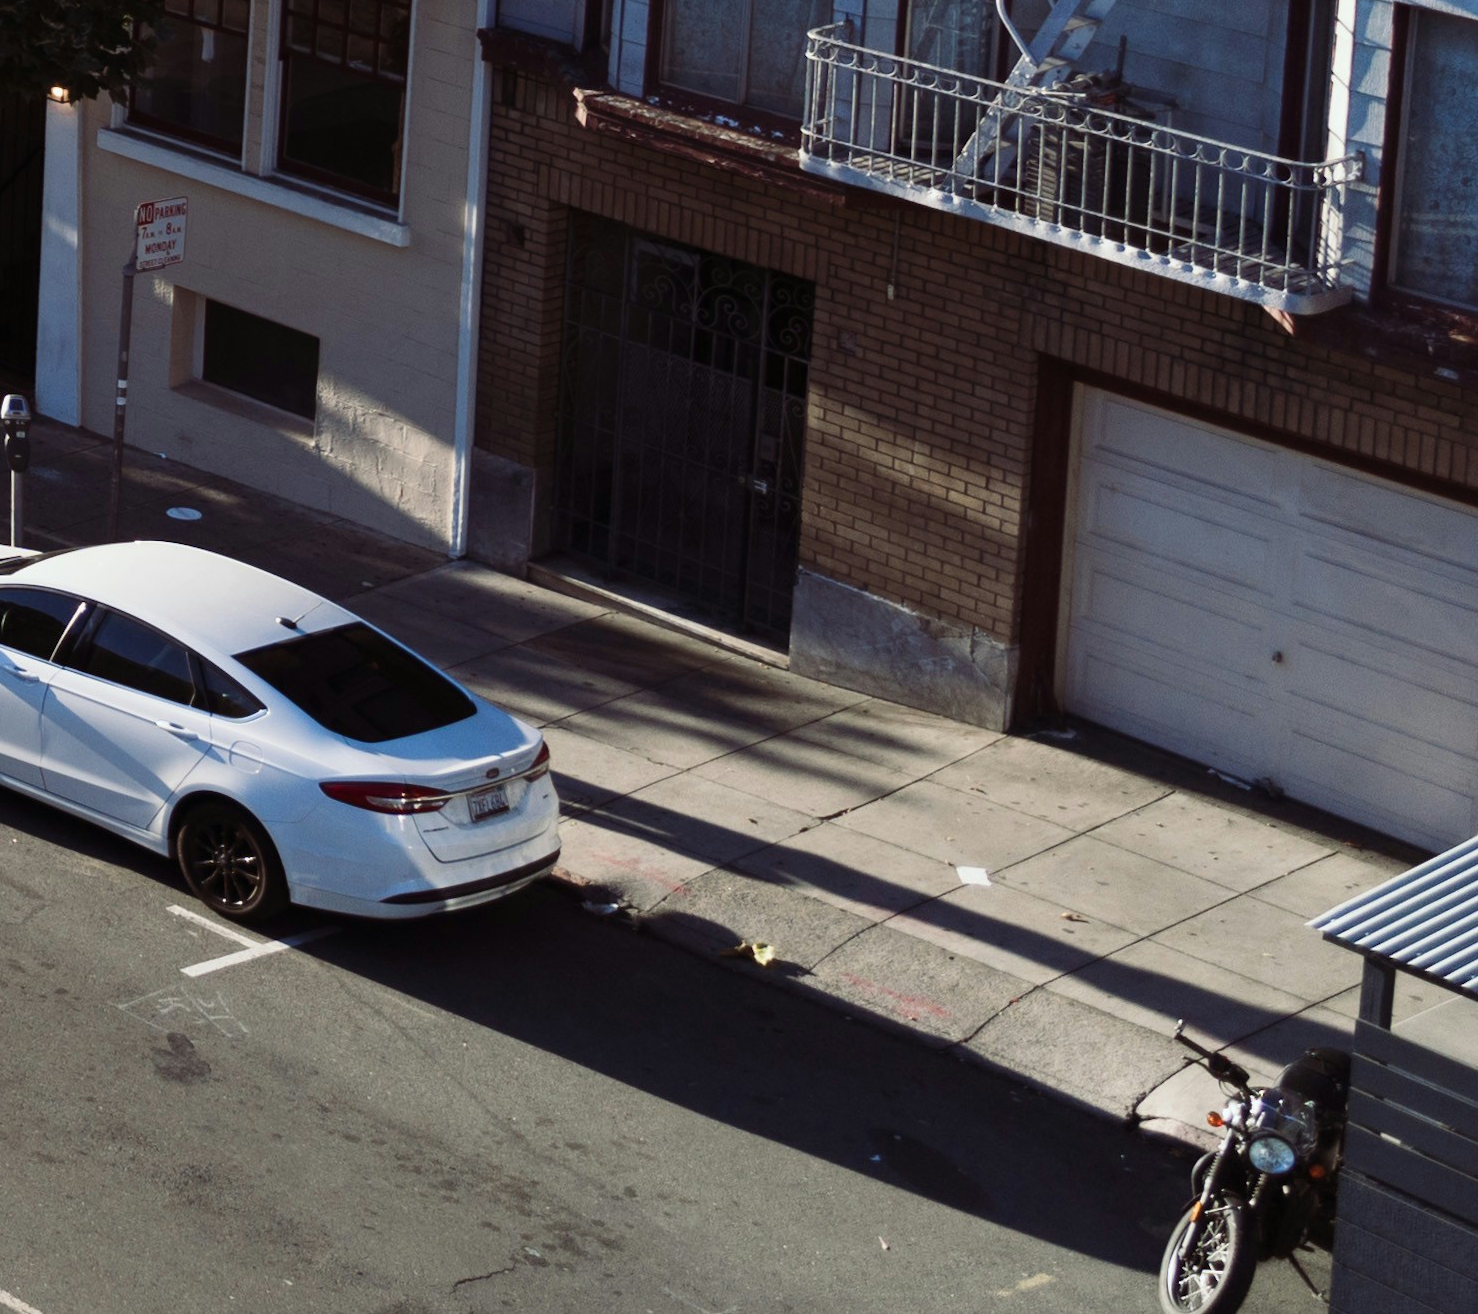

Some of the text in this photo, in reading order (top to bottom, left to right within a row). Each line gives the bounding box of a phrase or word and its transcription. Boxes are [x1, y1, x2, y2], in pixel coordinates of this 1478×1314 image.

[139, 202, 186, 223] NO PARKING
[144, 239, 177, 255] MONDAY
